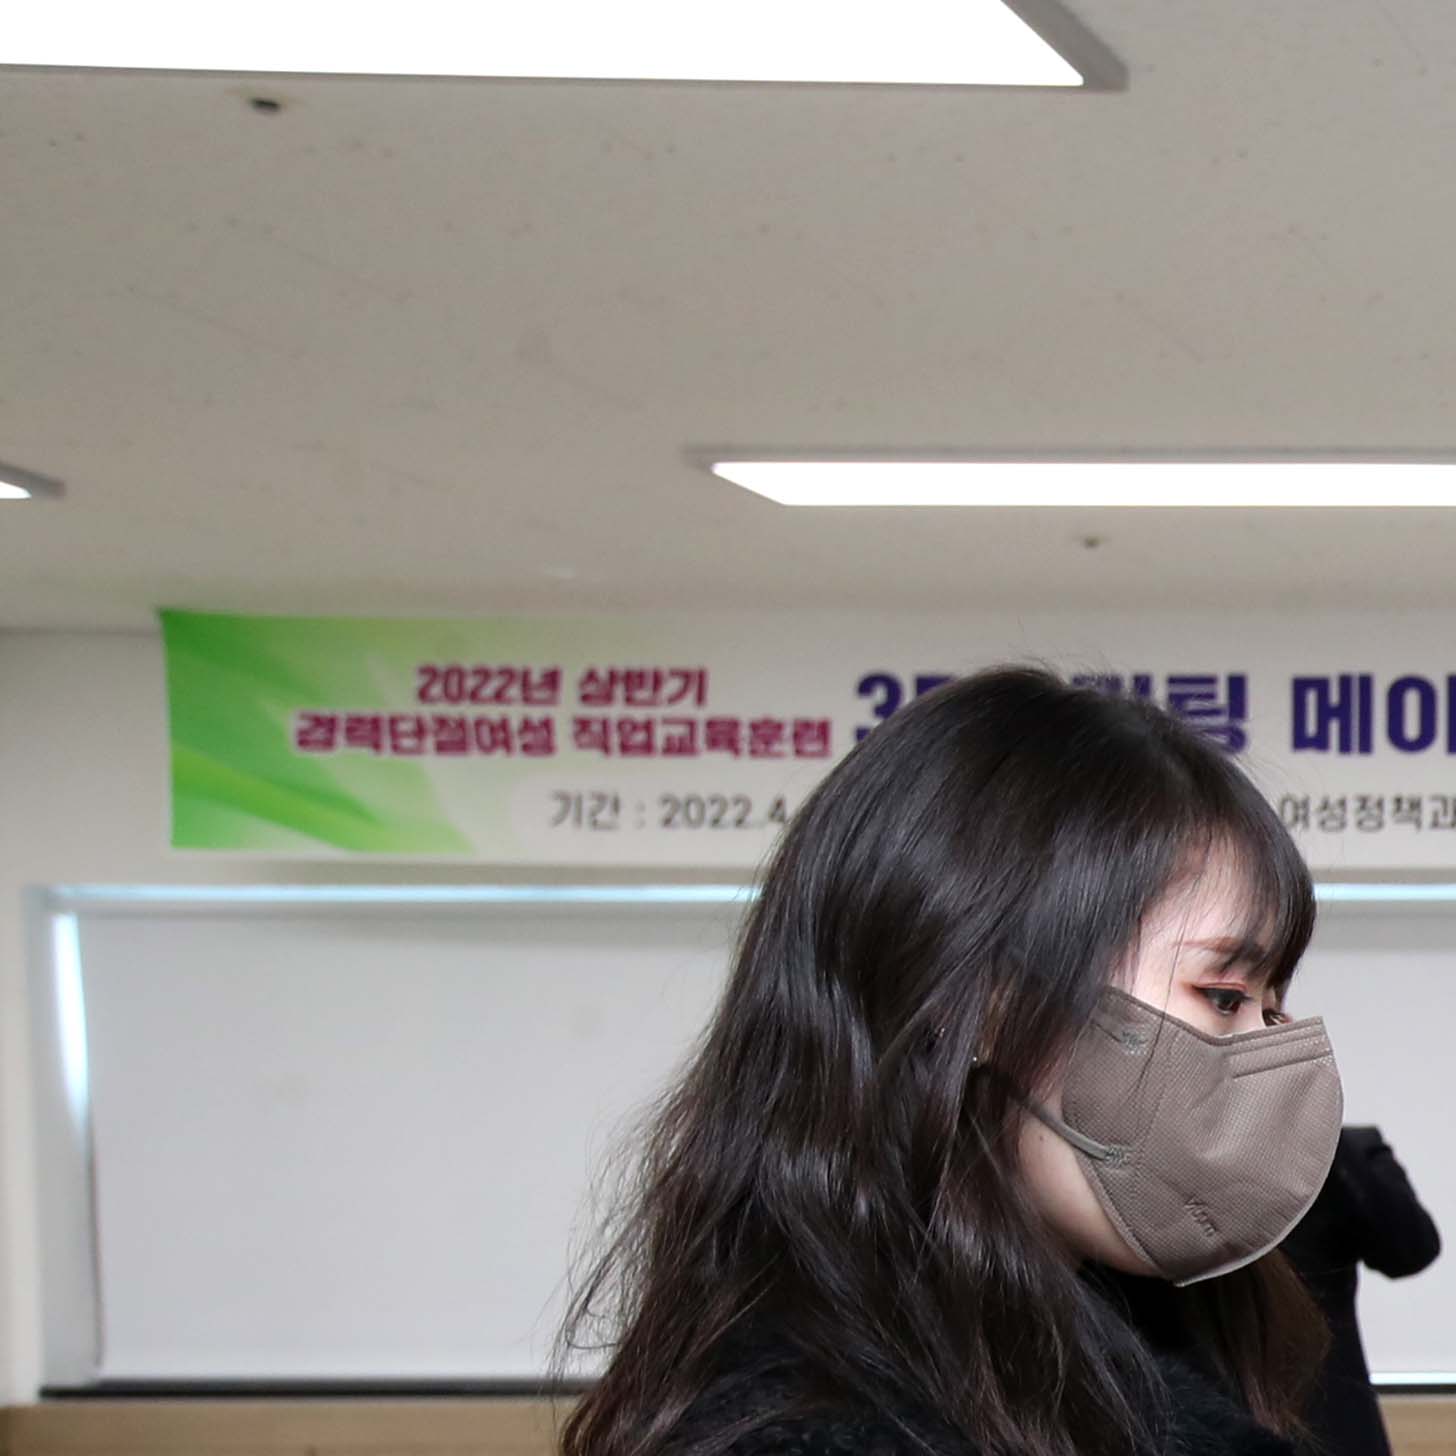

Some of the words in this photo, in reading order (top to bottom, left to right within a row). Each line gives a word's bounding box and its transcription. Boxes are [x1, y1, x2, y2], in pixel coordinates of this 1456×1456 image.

[416, 664, 562, 706] 2022년
[578, 667, 708, 707] 상반기
[296, 712, 556, 757] 경력단절여성
[571, 715, 832, 759] 직업교육훈련
[552, 790, 621, 831] 기간
